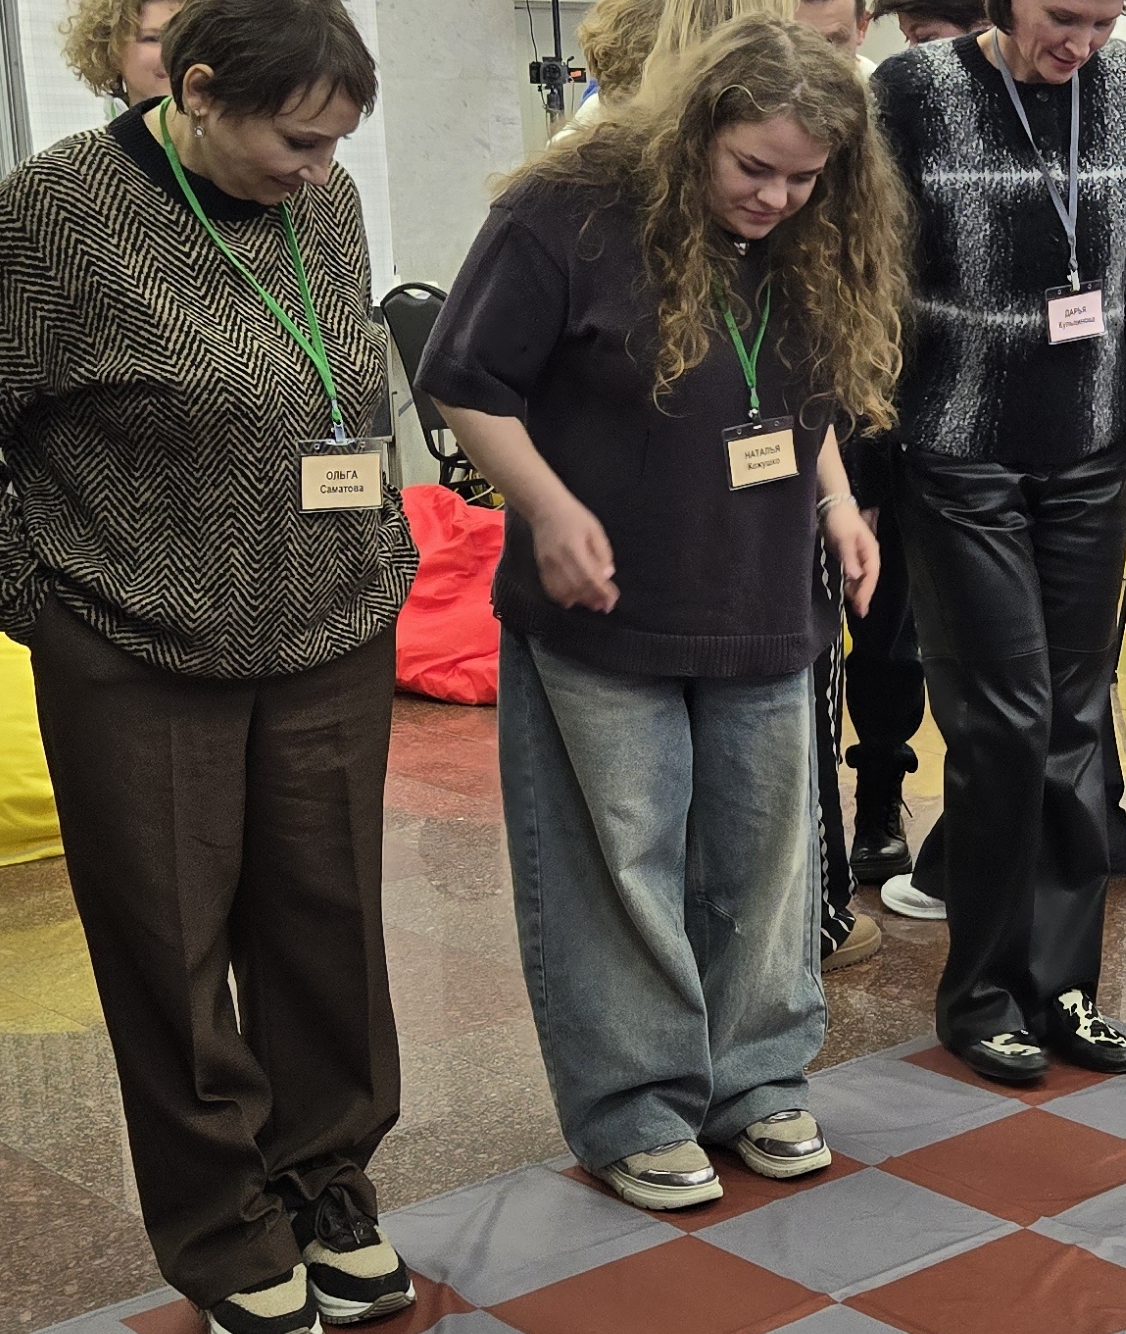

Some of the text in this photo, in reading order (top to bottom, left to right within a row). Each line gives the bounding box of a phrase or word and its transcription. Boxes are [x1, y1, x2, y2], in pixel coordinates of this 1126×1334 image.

[744, 444, 780, 459] НАТАЛЬЯ
[326, 470, 358, 480] ОЛЬГА
[320, 484, 364, 494] Саматова
